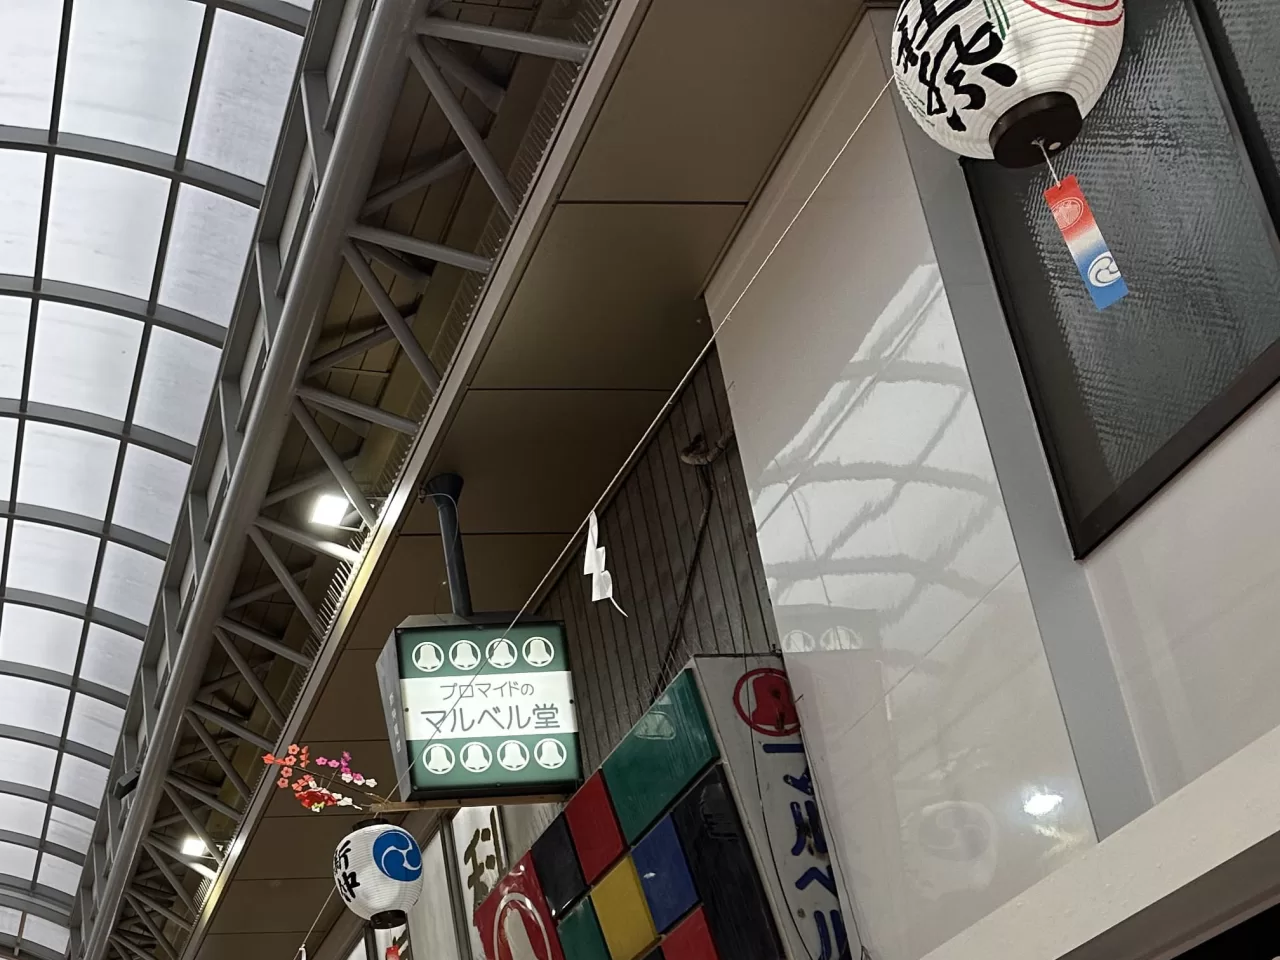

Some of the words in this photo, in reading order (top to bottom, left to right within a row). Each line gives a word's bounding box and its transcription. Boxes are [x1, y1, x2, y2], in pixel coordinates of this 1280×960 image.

[440, 680, 535, 701] プロマイドの
[420, 703, 561, 733] マルベル堂
